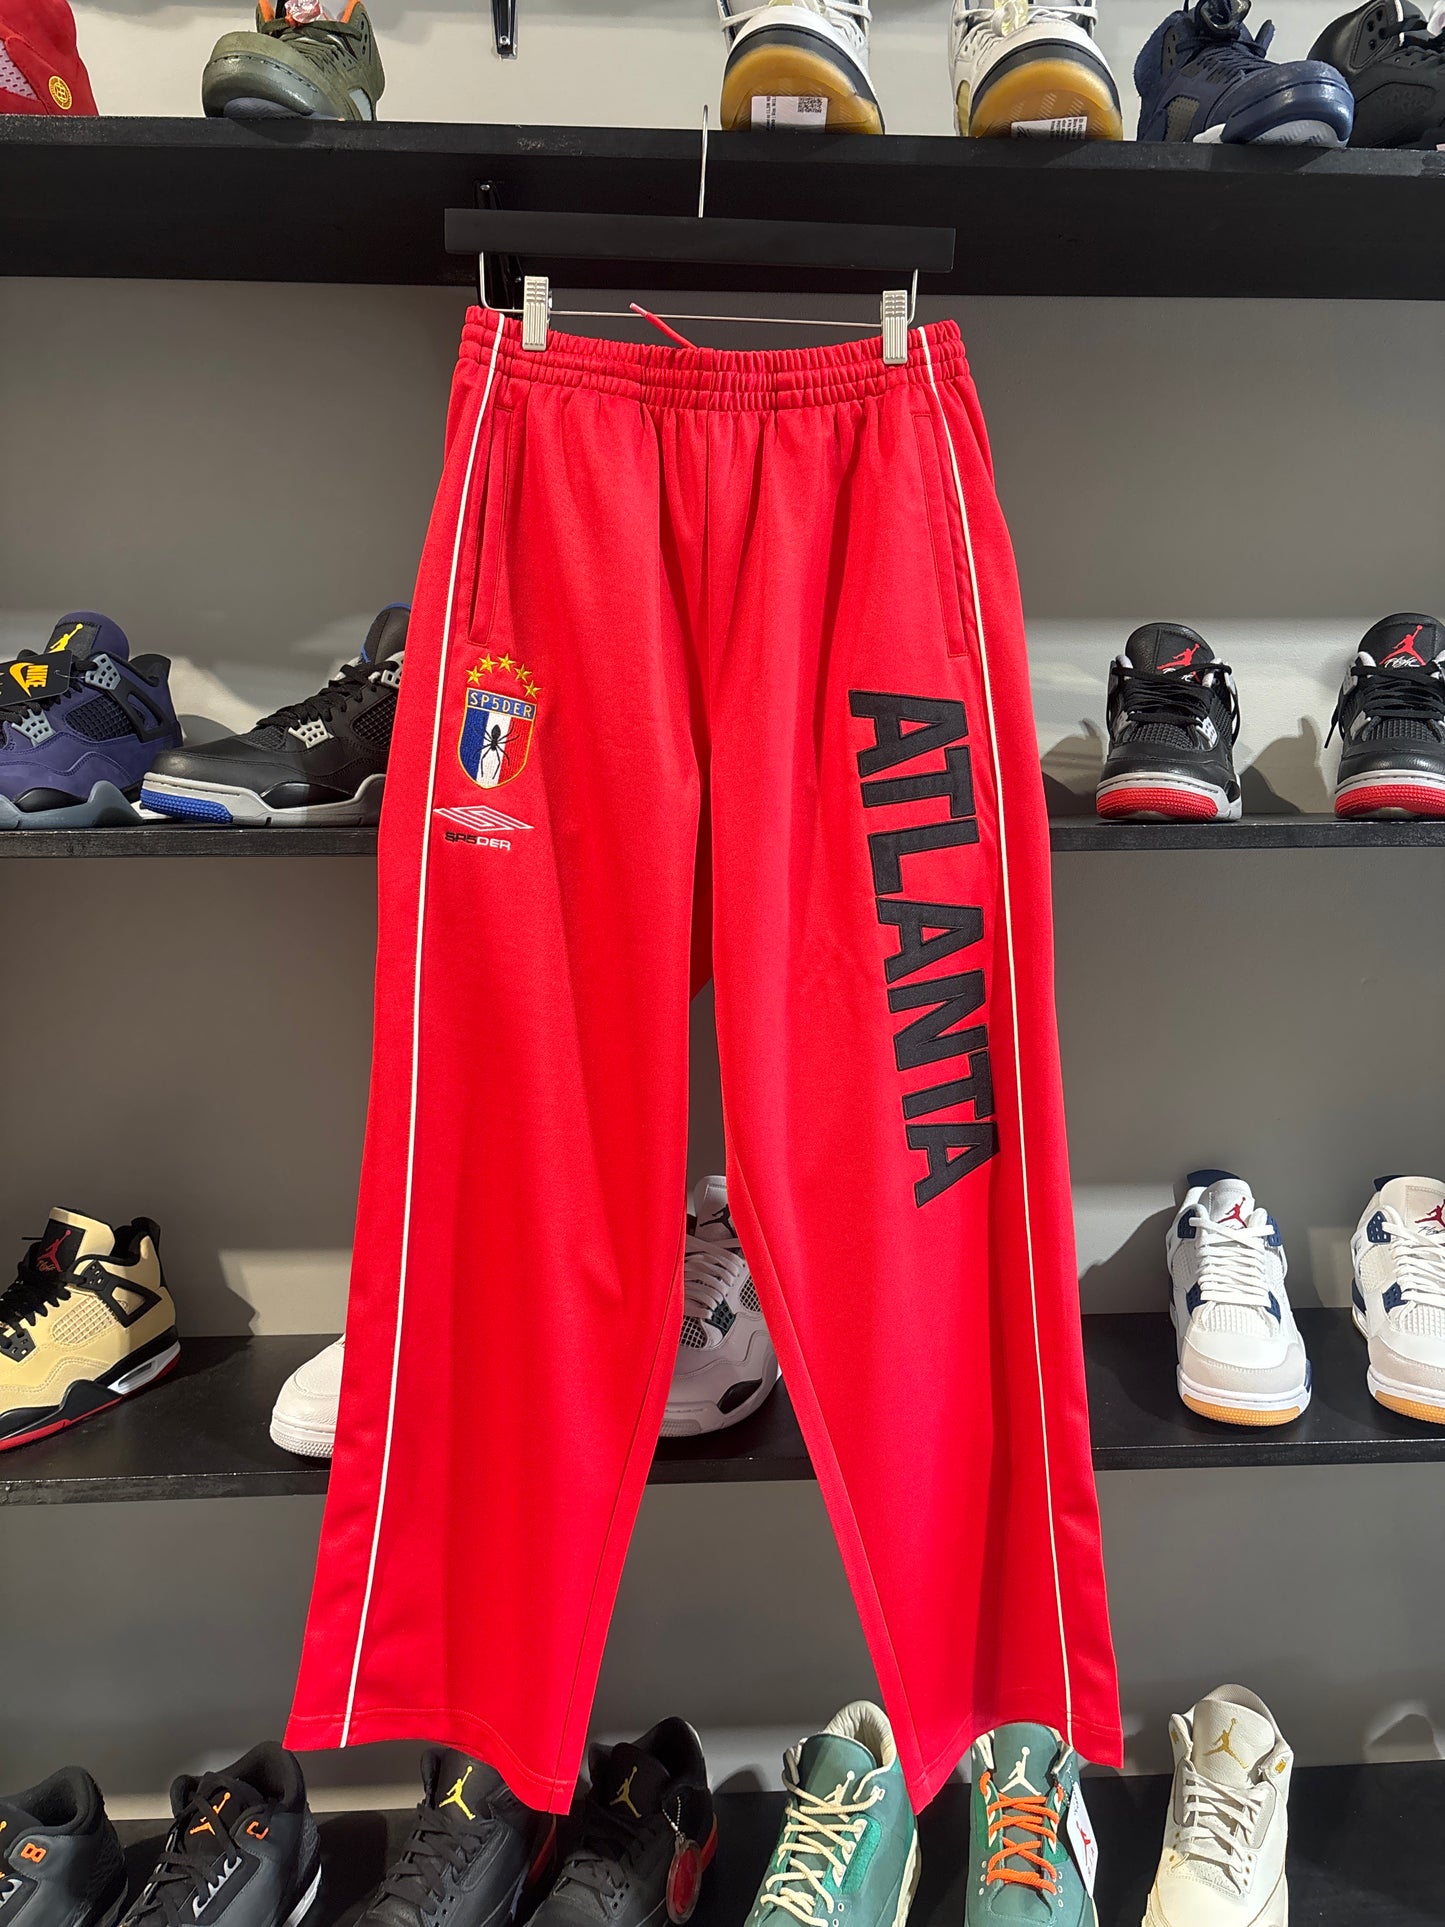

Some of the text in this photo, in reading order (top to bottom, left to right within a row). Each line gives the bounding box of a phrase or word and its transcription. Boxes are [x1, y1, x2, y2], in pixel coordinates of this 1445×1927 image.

[25, 664, 49, 688] NIKE
[469, 692, 533, 718] SP5DER
[444, 832, 511, 851] SP5DER
[848, 689, 1000, 1208] ATLANTA
